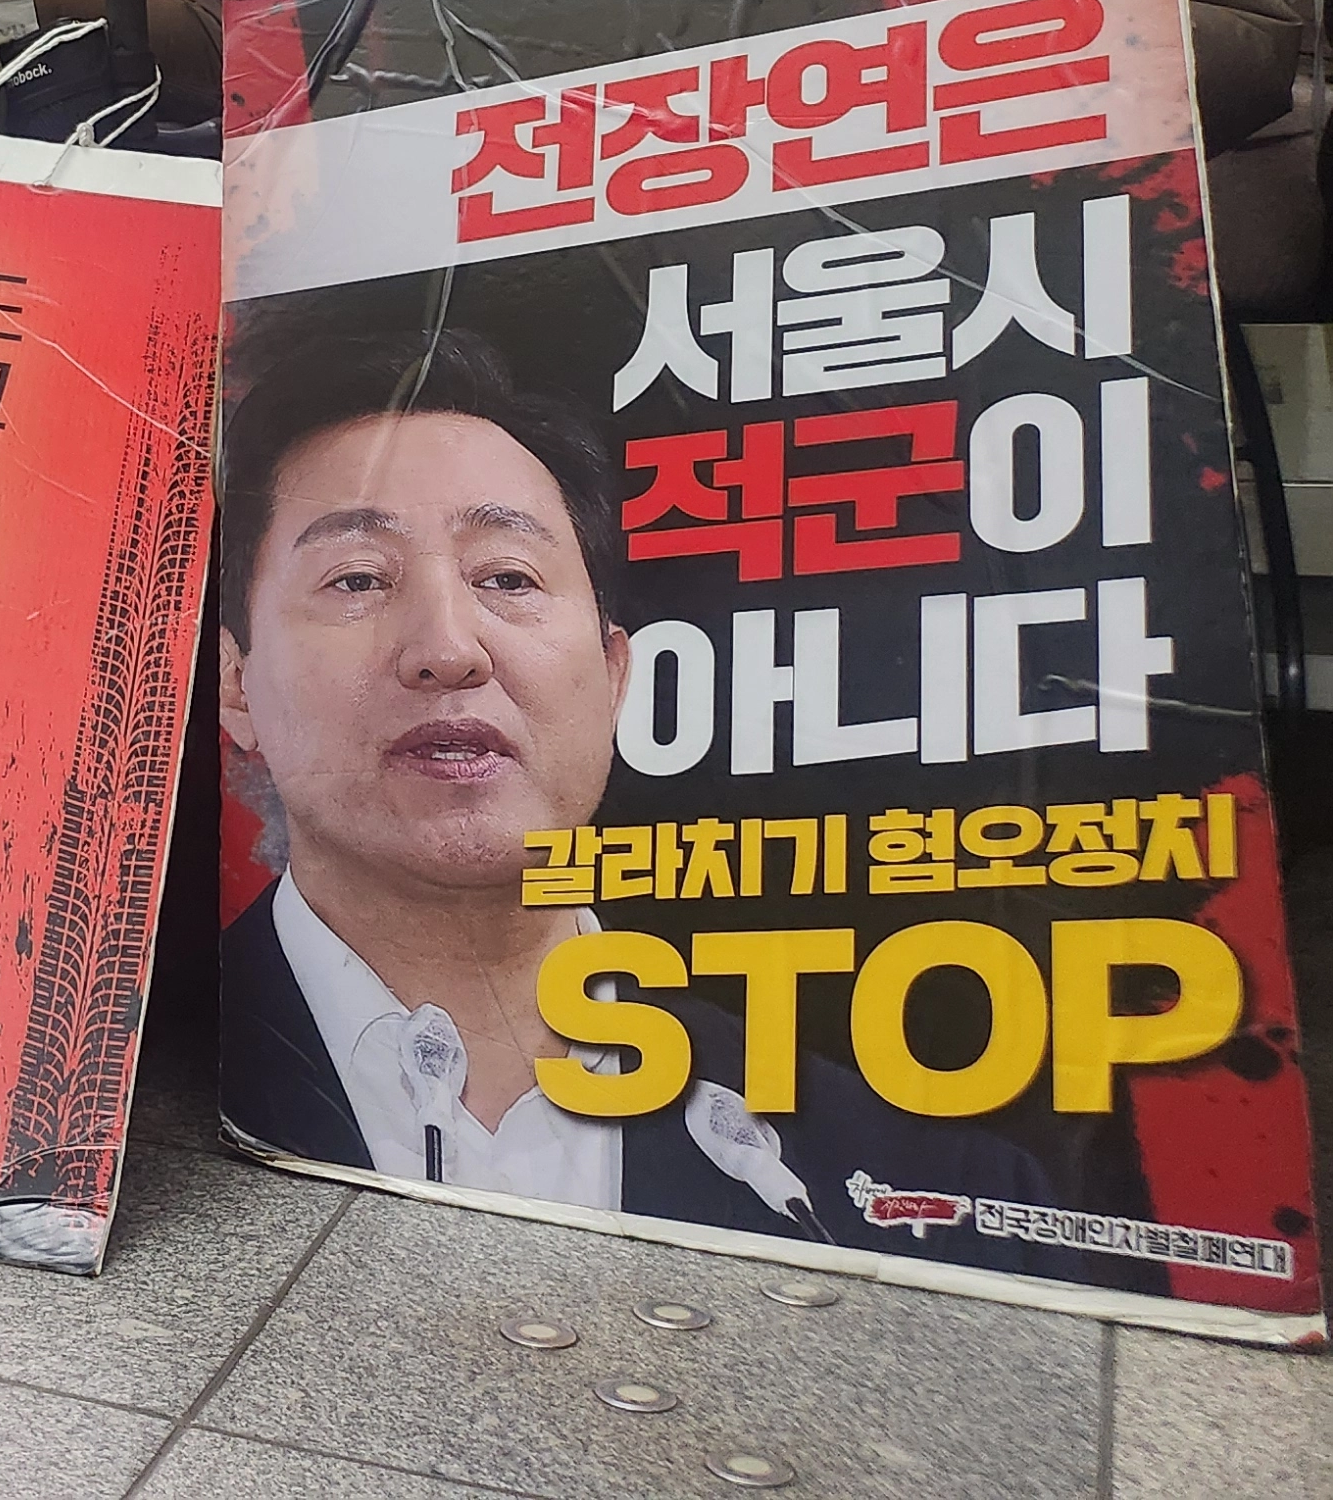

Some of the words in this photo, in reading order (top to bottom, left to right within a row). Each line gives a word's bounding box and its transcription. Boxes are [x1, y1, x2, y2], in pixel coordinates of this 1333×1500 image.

[10, 63, 53, 89] obock.
[613, 193, 1134, 414] 서울시
[621, 376, 1154, 584] 적군이
[616, 577, 1175, 778] 아니다
[522, 814, 848, 906] 갈라치기
[868, 793, 1239, 895] 혐오정치
[534, 918, 1246, 1119] STOP
[976, 1201, 1289, 1274] 전국장애인차별철폐연대
